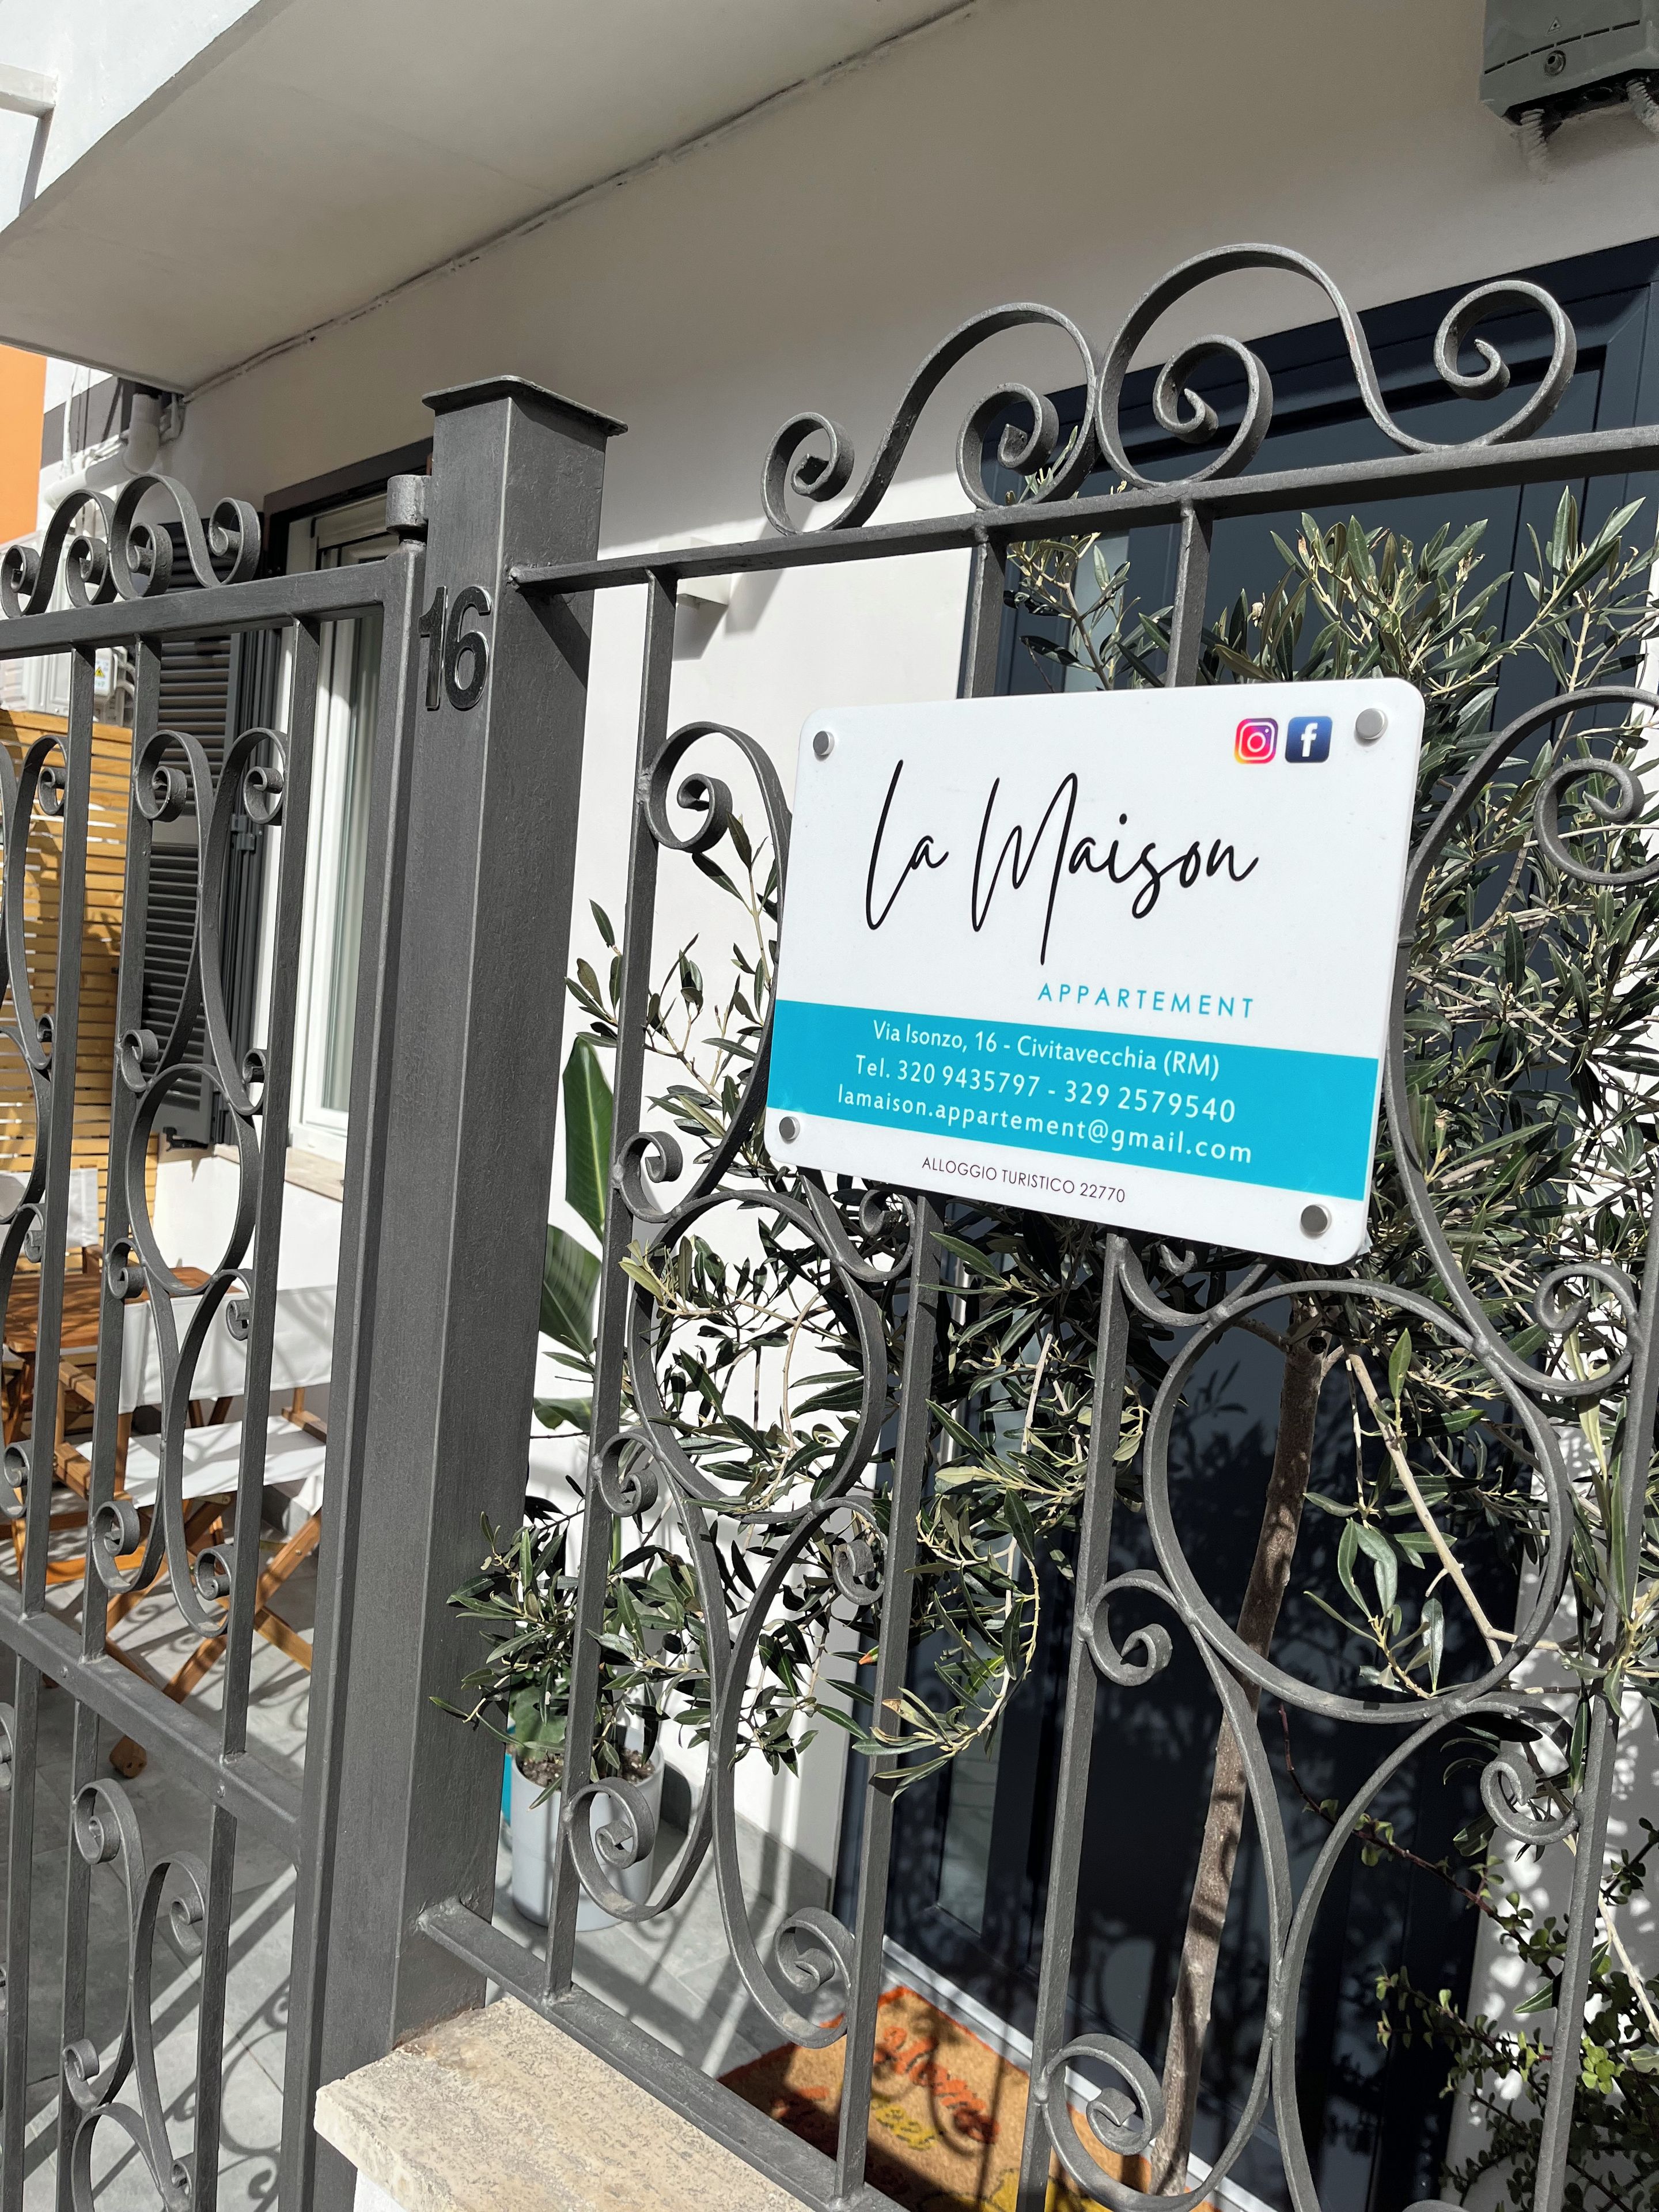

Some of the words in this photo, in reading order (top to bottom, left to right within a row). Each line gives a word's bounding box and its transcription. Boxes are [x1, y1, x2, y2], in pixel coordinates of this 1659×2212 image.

[418, 586, 491, 711] 16
[865, 759, 950, 931] La
[971, 772, 1260, 967] Maison
[1036, 982, 1254, 1019] APPARTEMENT
[873, 1020, 901, 1042] Via
[906, 1023, 968, 1052] Isonzo,
[975, 1031, 998, 1053] 16
[1017, 1035, 1157, 1071] Civitavecchia
[1163, 1050, 1219, 1082] (RM)
[855, 1054, 891, 1079] Tel.
[897, 1059, 935, 1085] 320
[942, 1065, 1041, 1097] 9435797
[1064, 1080, 1110, 1107] 329
[1117, 1086, 1236, 1123] 2579540
[838, 1083, 1252, 1164] lamaison.appartement@gmail.com
[921, 1156, 998, 1181] ALLOGGIO
[1002, 1169, 1075, 1194] TURISTICO
[1079, 1182, 1126, 1203] 22770
